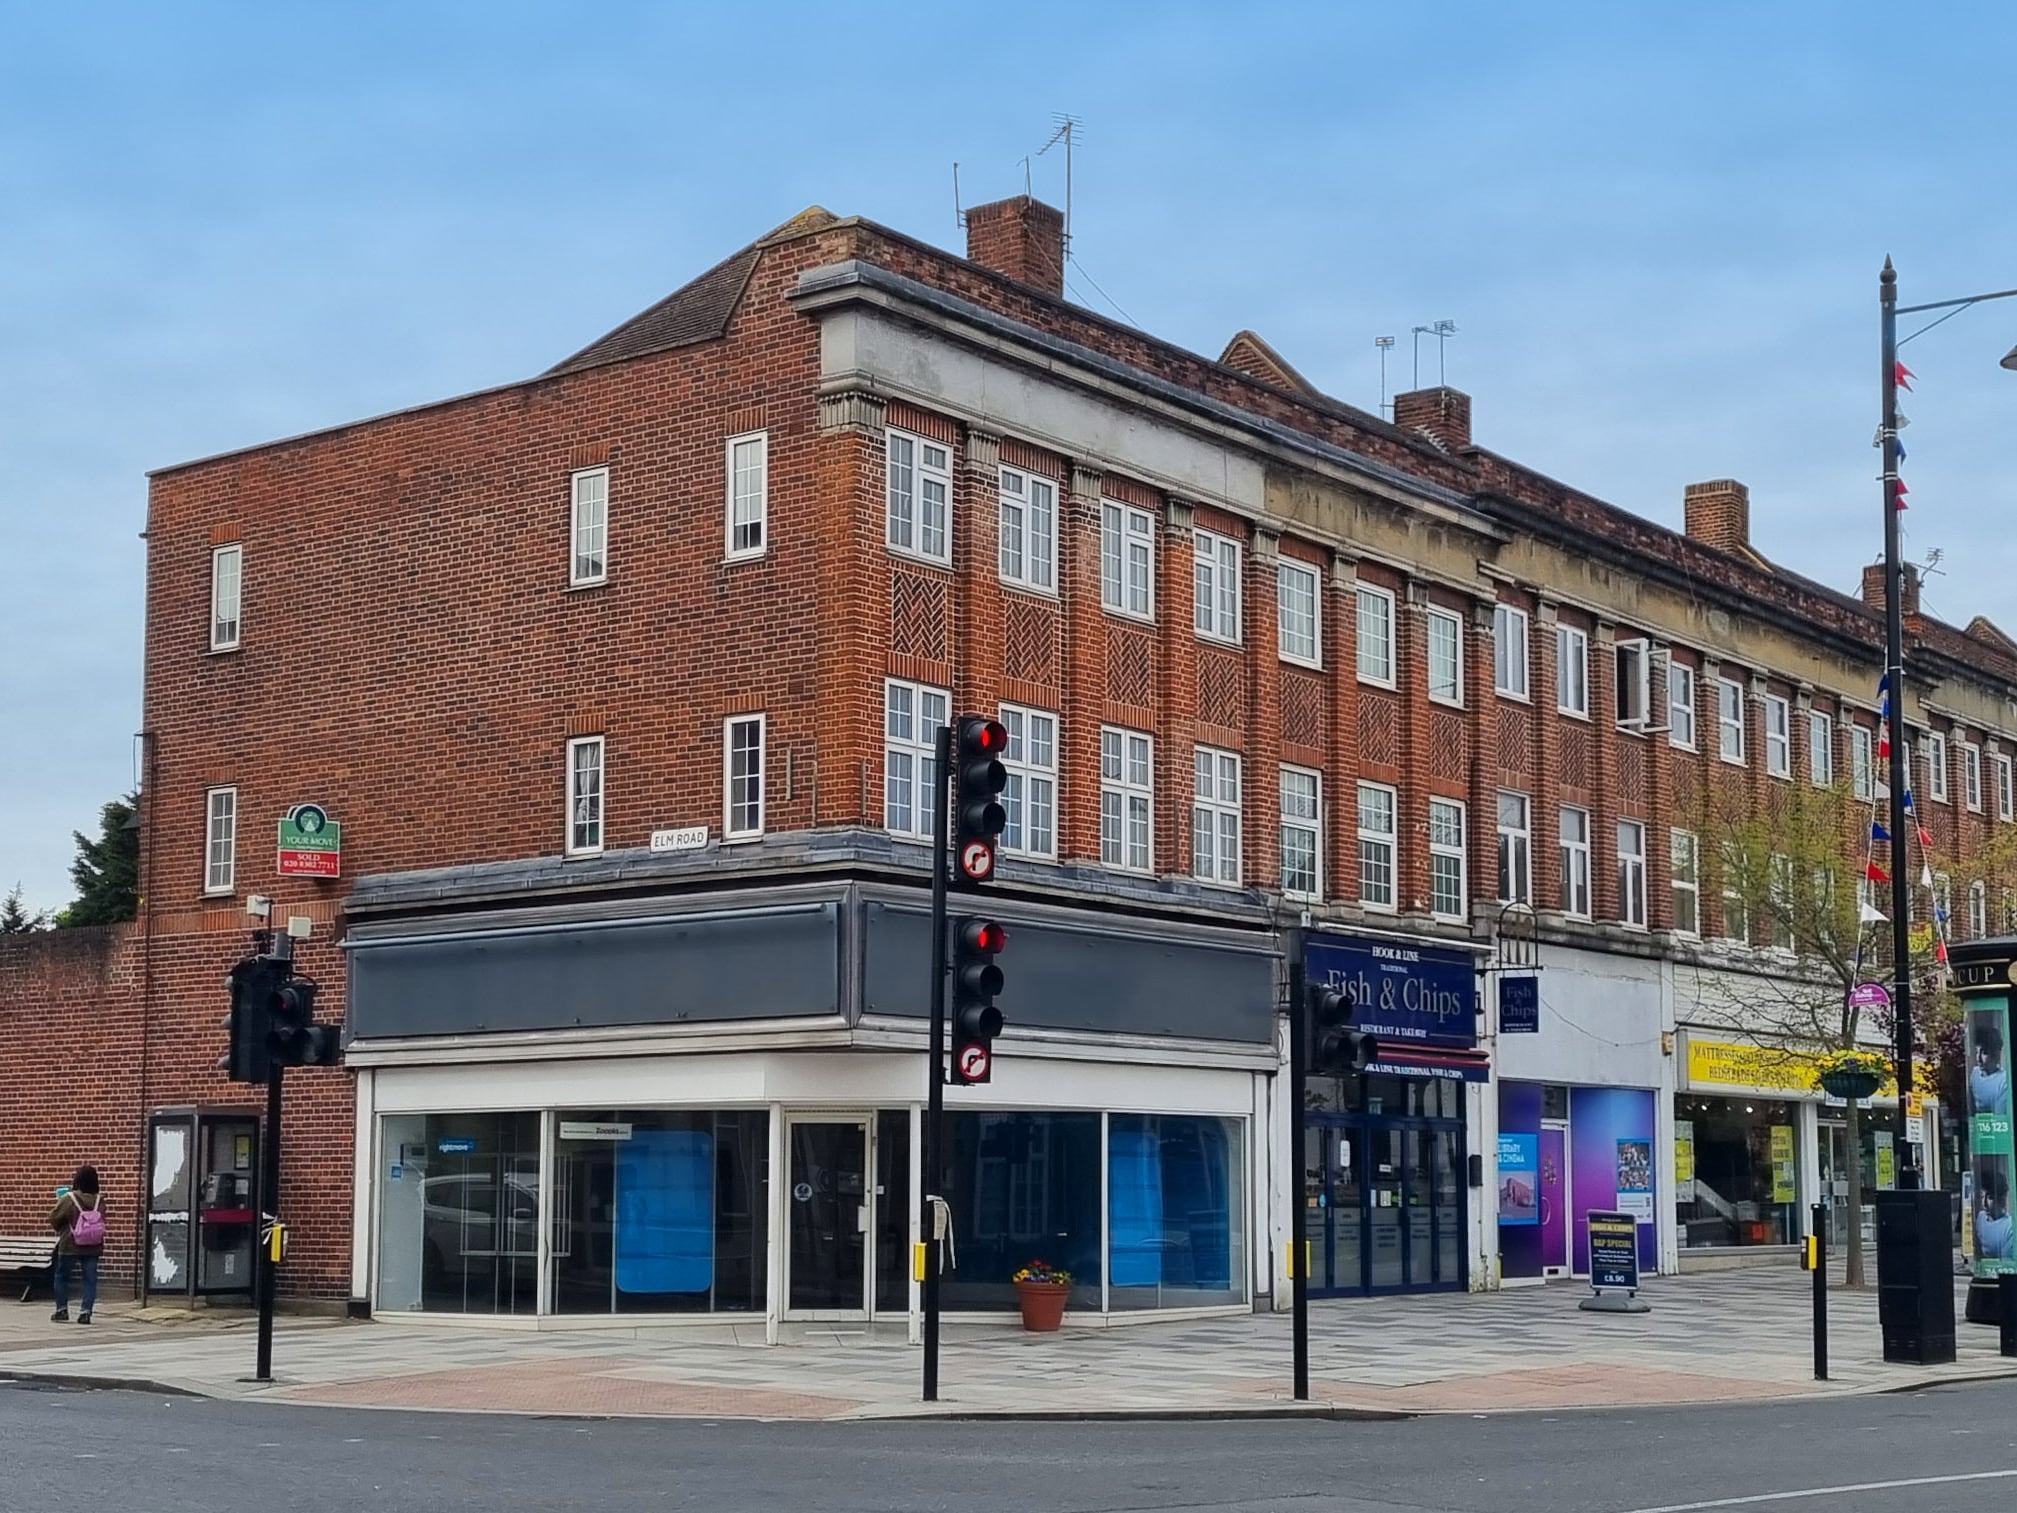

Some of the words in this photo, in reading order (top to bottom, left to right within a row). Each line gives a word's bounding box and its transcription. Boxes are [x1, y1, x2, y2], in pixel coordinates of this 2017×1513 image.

[286, 836, 309, 845] YOUR
[310, 837, 333, 846] MOVE
[654, 834, 674, 847] ELM
[676, 831, 704, 845] ROAD
[297, 853, 320, 861] SOLD
[1372, 946, 1394, 959] HOOK
[1396, 949, 1402, 960] &
[1402, 950, 1420, 962] LINE
[1327, 969, 1372, 1006] Fish
[1379, 977, 1397, 1011] &
[1402, 977, 1462, 1024] Chips
[1992, 1122, 2008, 1132] 123
